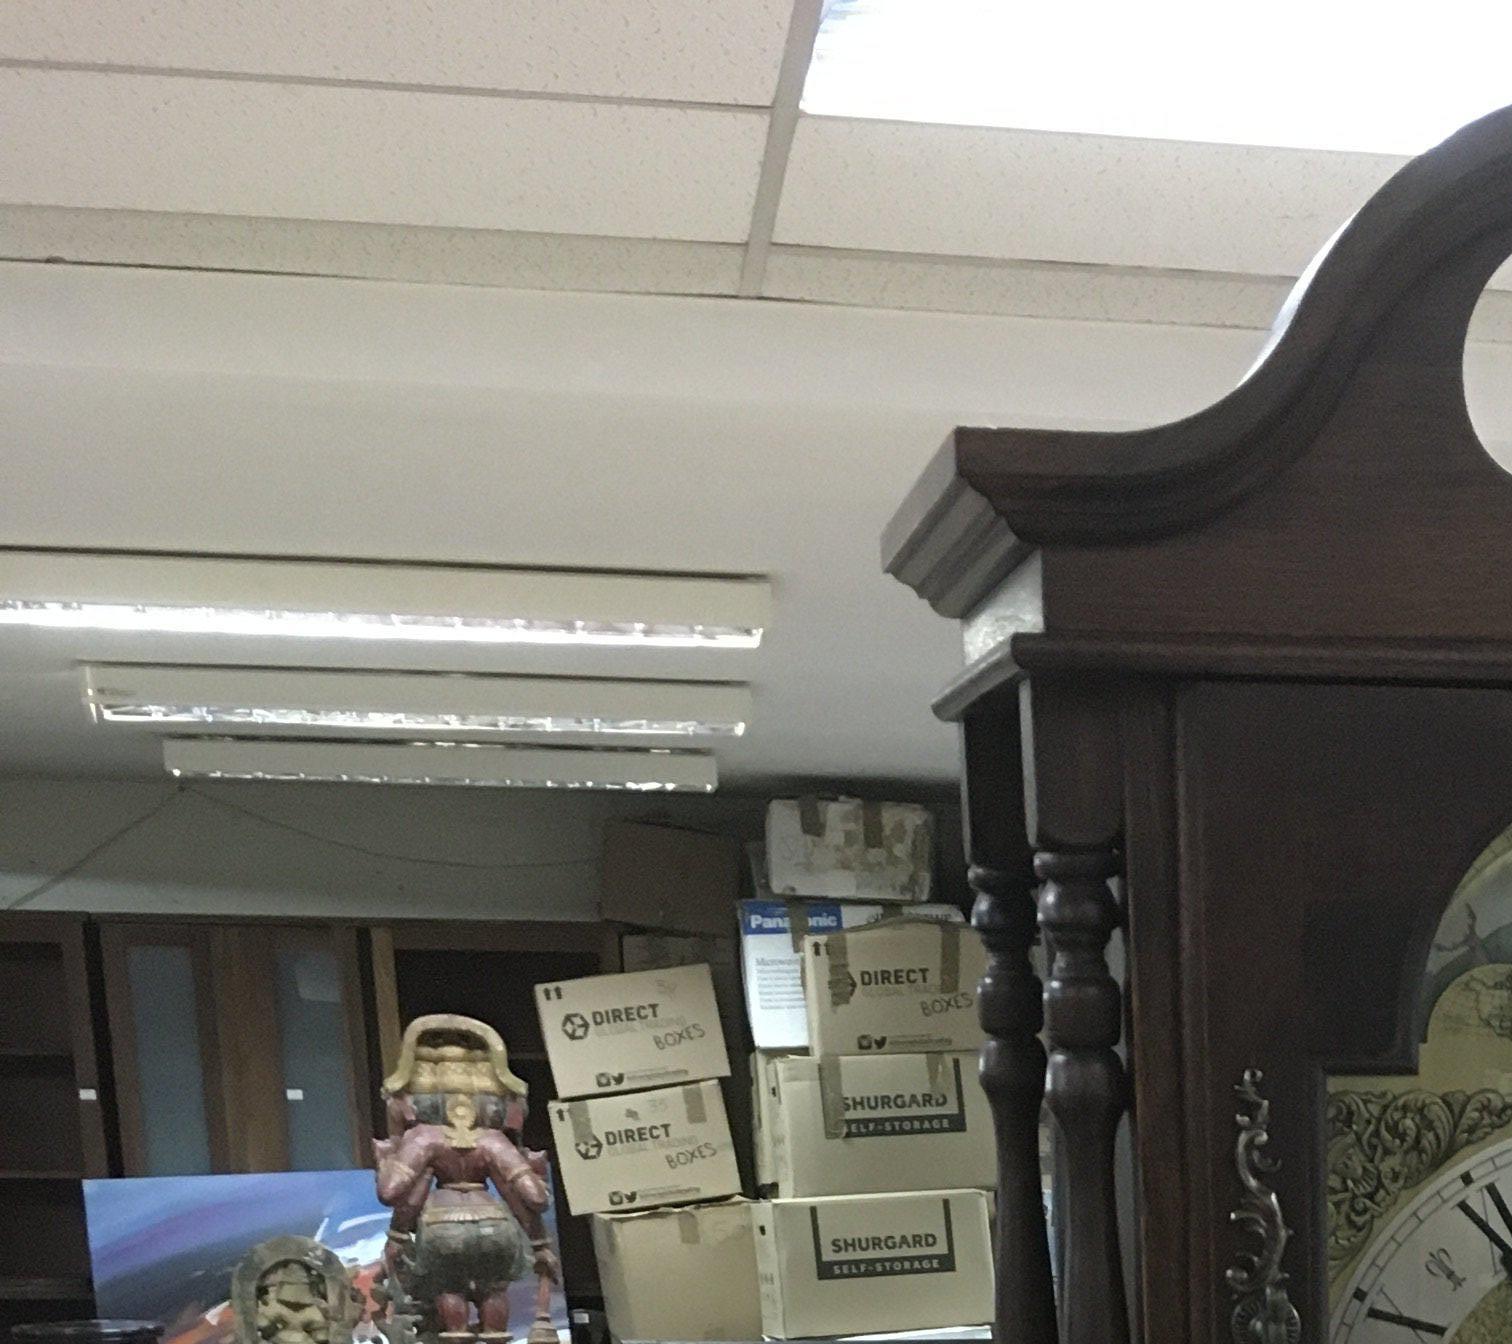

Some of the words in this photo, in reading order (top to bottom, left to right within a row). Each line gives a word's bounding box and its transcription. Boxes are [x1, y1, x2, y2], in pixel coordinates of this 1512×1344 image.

[860, 968, 929, 986] DIRECT
[592, 1003, 659, 1026] DIRECT
[921, 993, 973, 1017] BOXES
[653, 1023, 706, 1050] BOXES
[842, 1093, 948, 1112] SHURGARD
[604, 1123, 672, 1146] DIRECT
[846, 1118, 950, 1134] ELF-STORAGE
[665, 1142, 718, 1170] BOXES
[831, 1233, 938, 1254] SHURGARD
[833, 1259, 940, 1275] SELF-STORAGE
